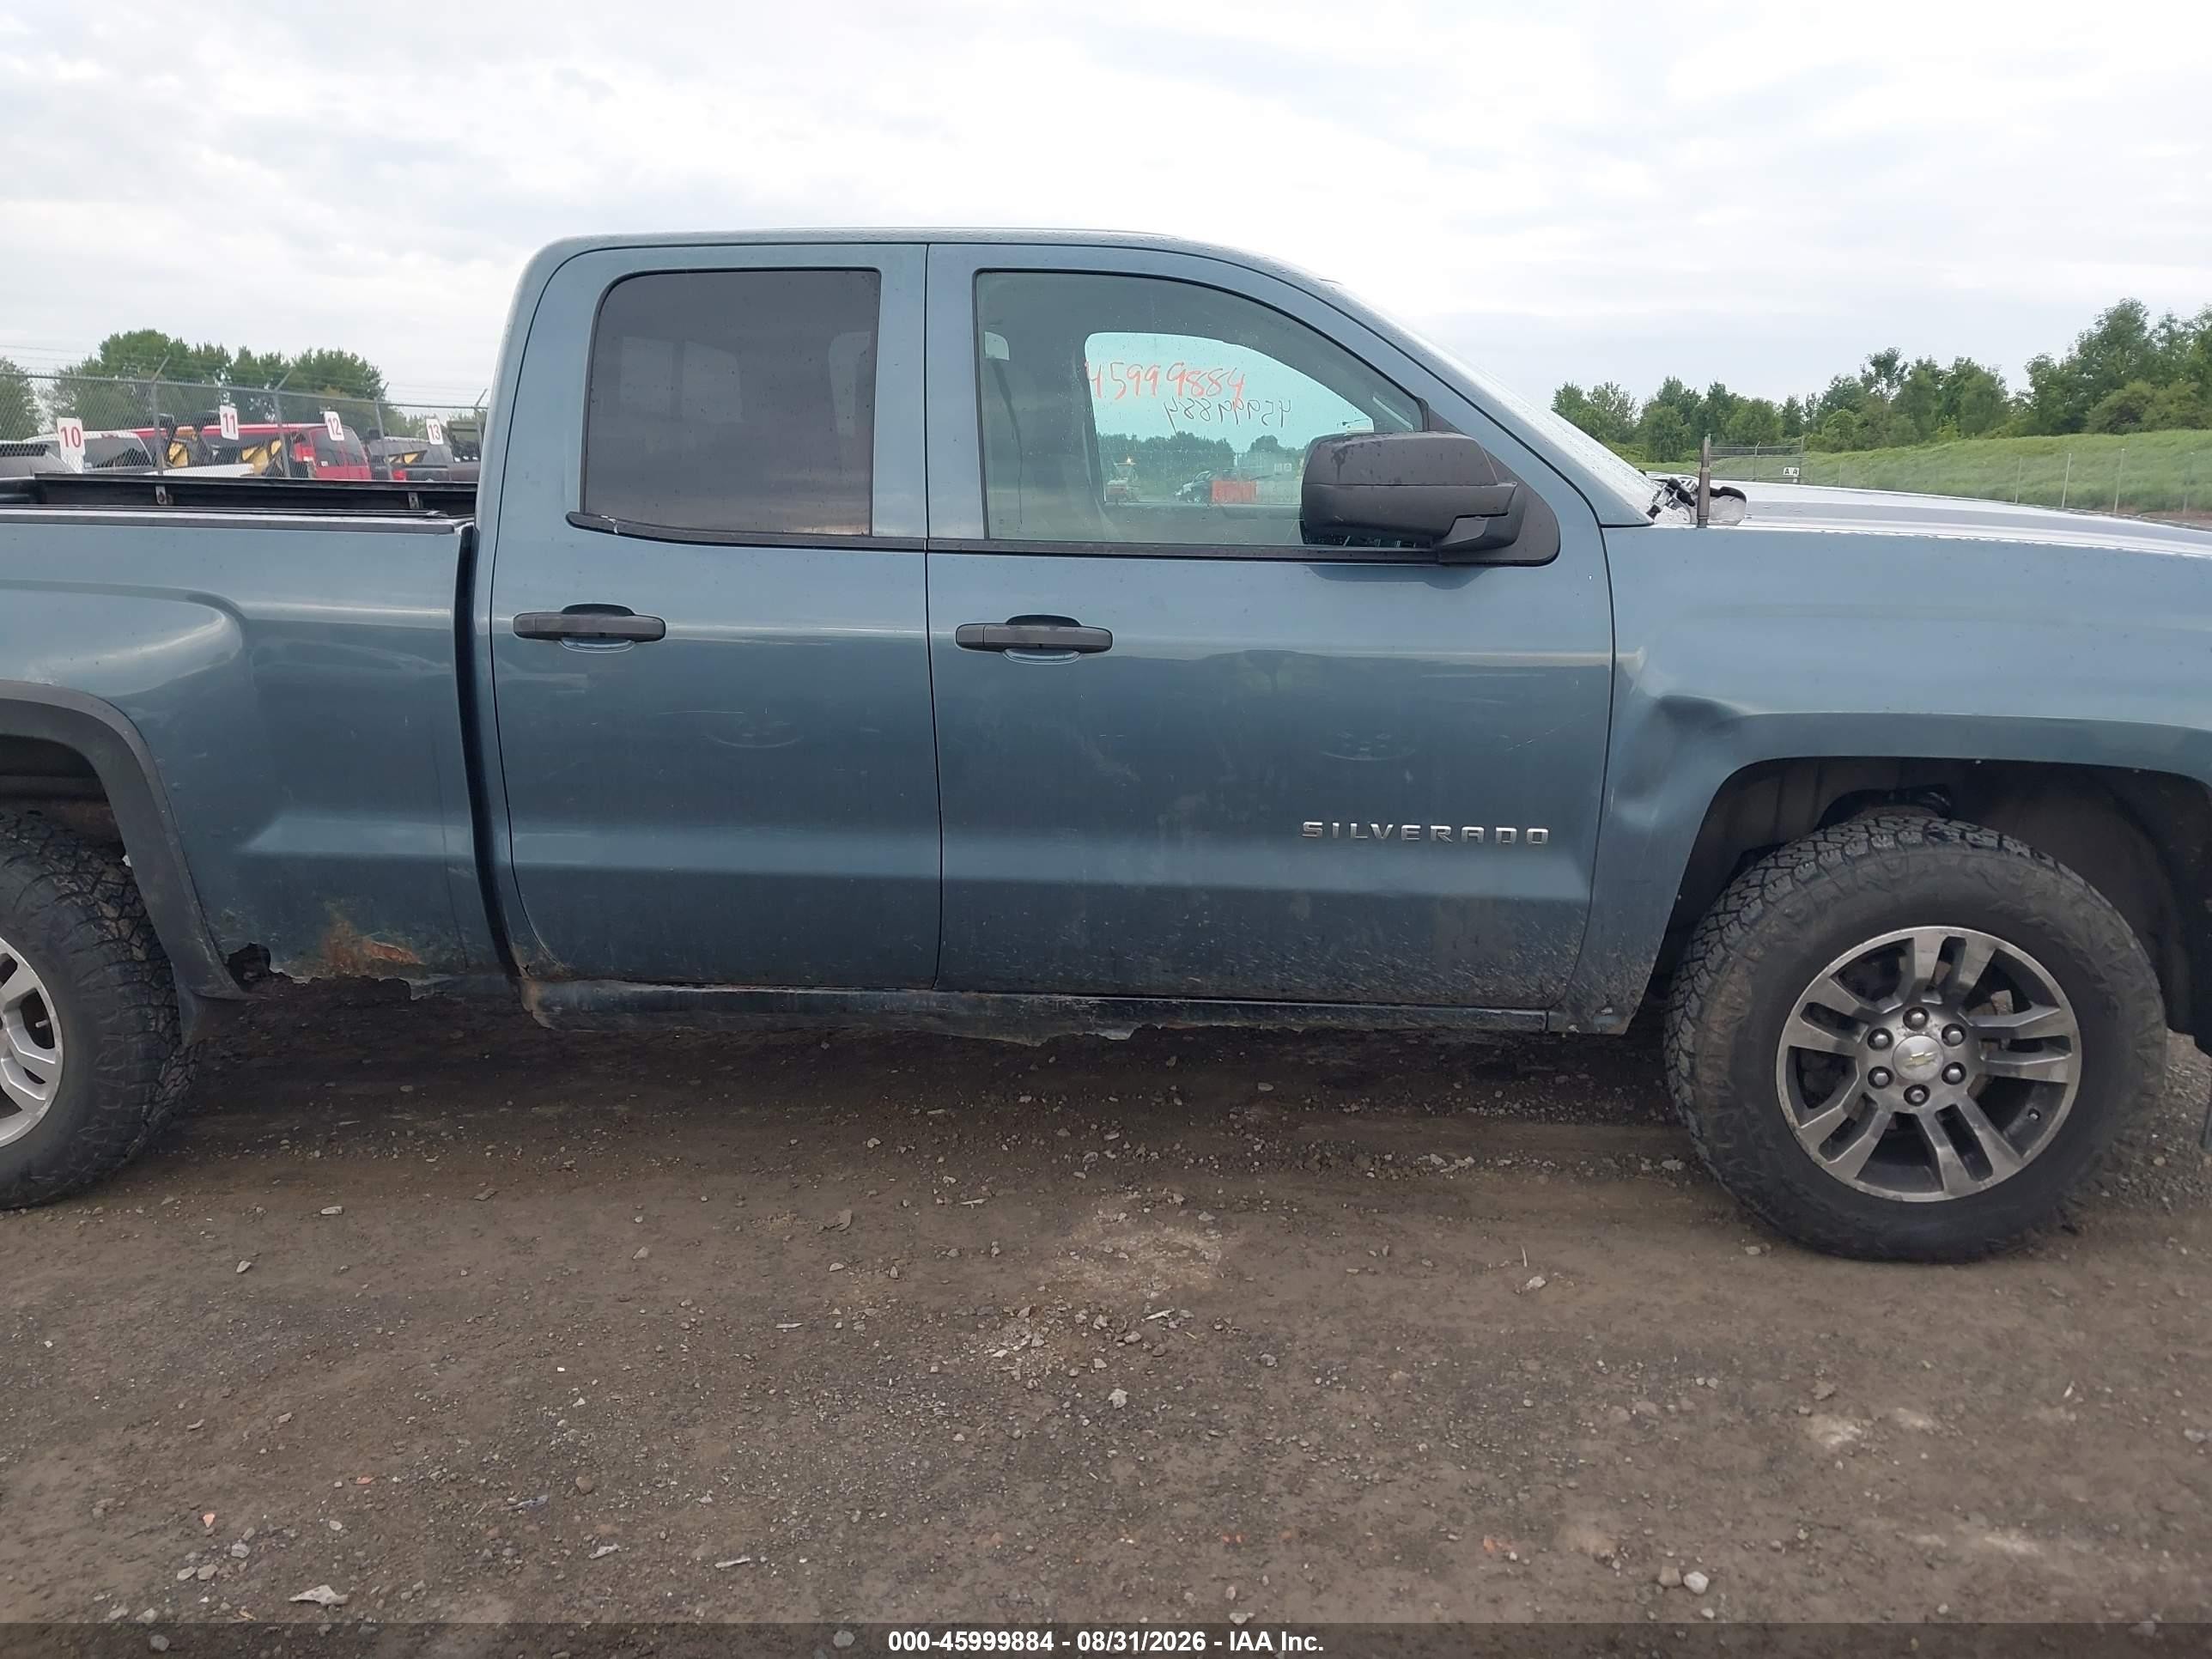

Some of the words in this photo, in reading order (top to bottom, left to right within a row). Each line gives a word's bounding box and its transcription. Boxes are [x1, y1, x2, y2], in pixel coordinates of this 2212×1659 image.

[1085, 361, 1244, 410] 45999884
[222, 412, 236, 434] 11
[327, 417, 342, 435] 12
[428, 424, 441, 441] 13
[61, 426, 82, 448] 10
[1302, 821, 1550, 845] SILVERADO
